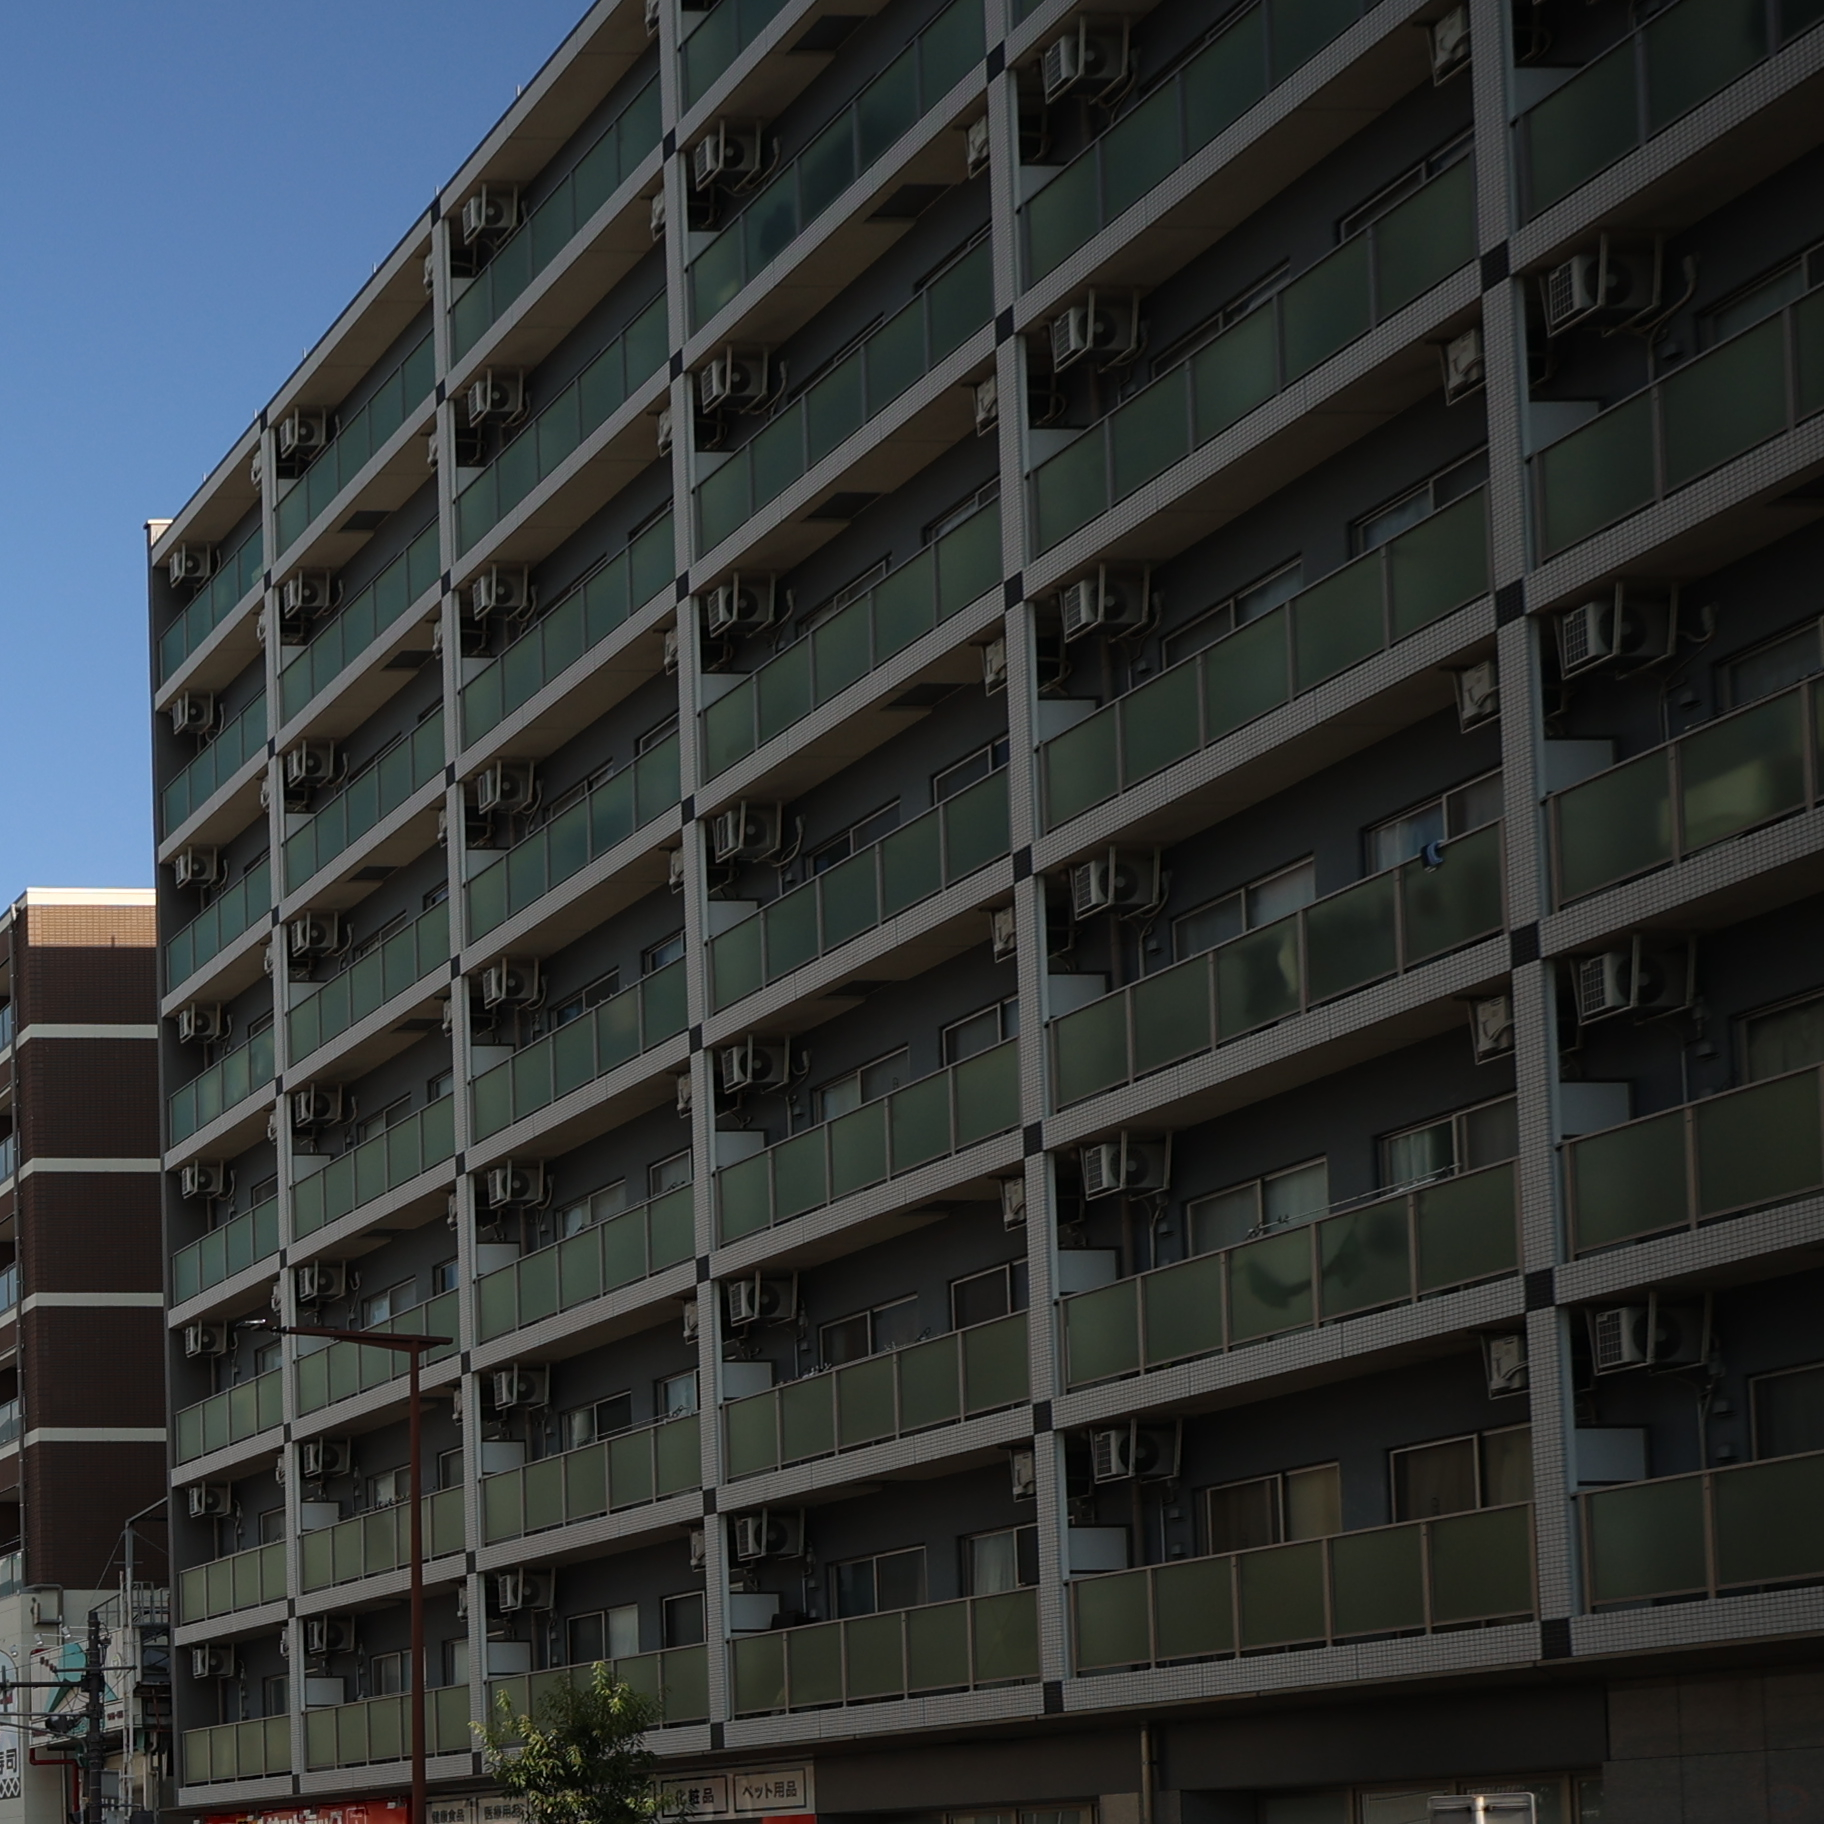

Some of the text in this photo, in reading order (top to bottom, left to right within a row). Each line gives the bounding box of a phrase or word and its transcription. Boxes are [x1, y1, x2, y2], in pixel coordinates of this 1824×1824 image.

[676, 1787, 714, 1805] 化粧品
[743, 1780, 797, 1799] ペット用品
[432, 1811, 465, 1824] 健康食品
